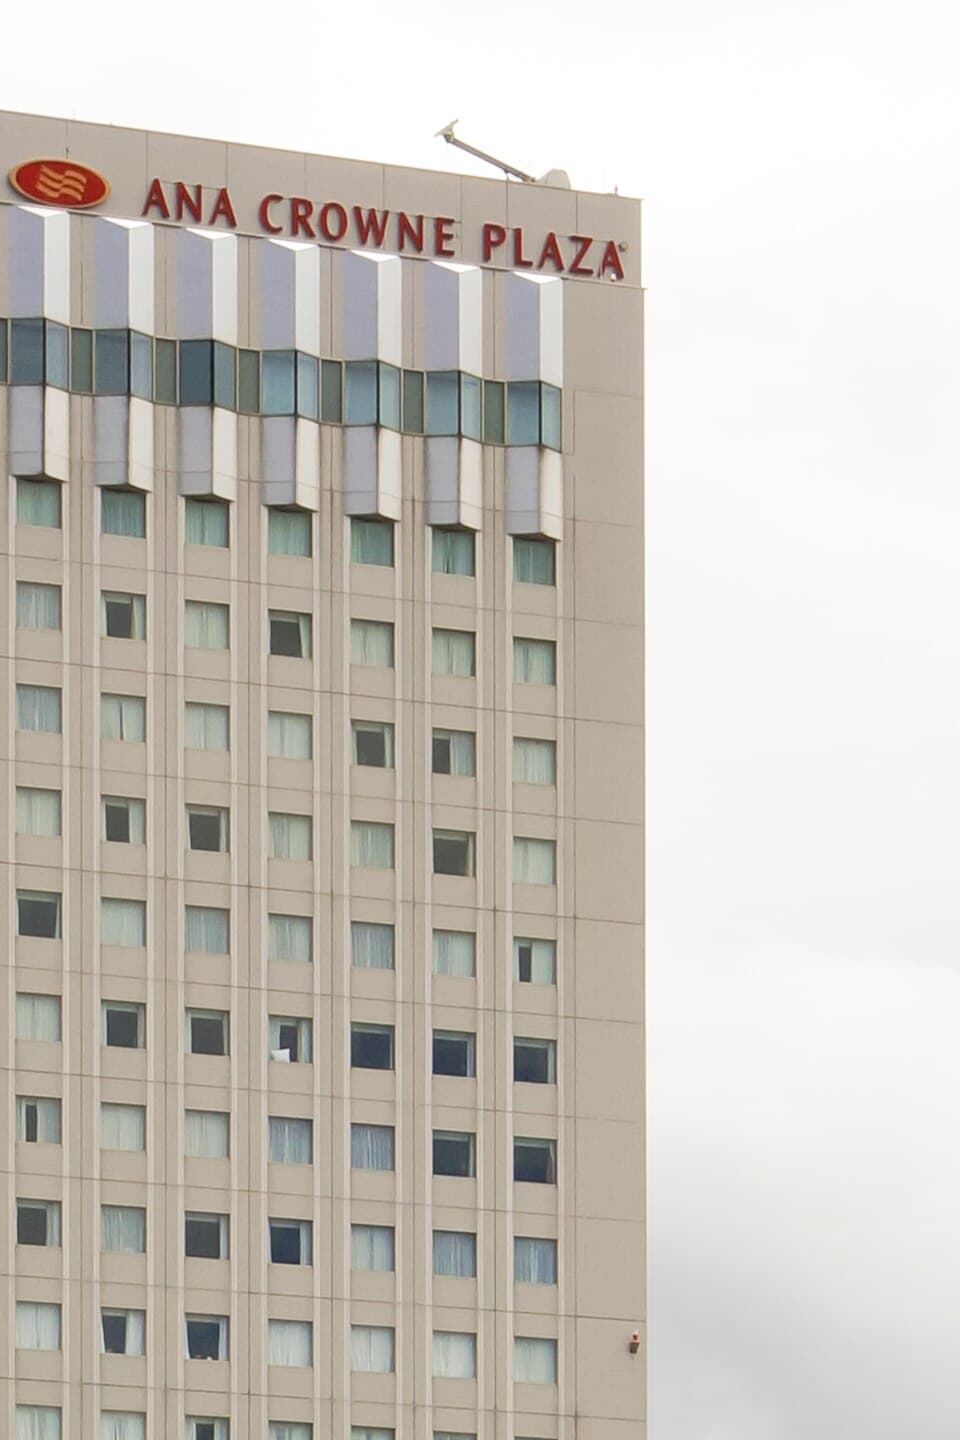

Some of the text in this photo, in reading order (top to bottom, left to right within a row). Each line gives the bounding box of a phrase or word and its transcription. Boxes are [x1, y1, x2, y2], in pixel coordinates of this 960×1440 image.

[142, 178, 625, 280] ANA CROWNE PLAZA
